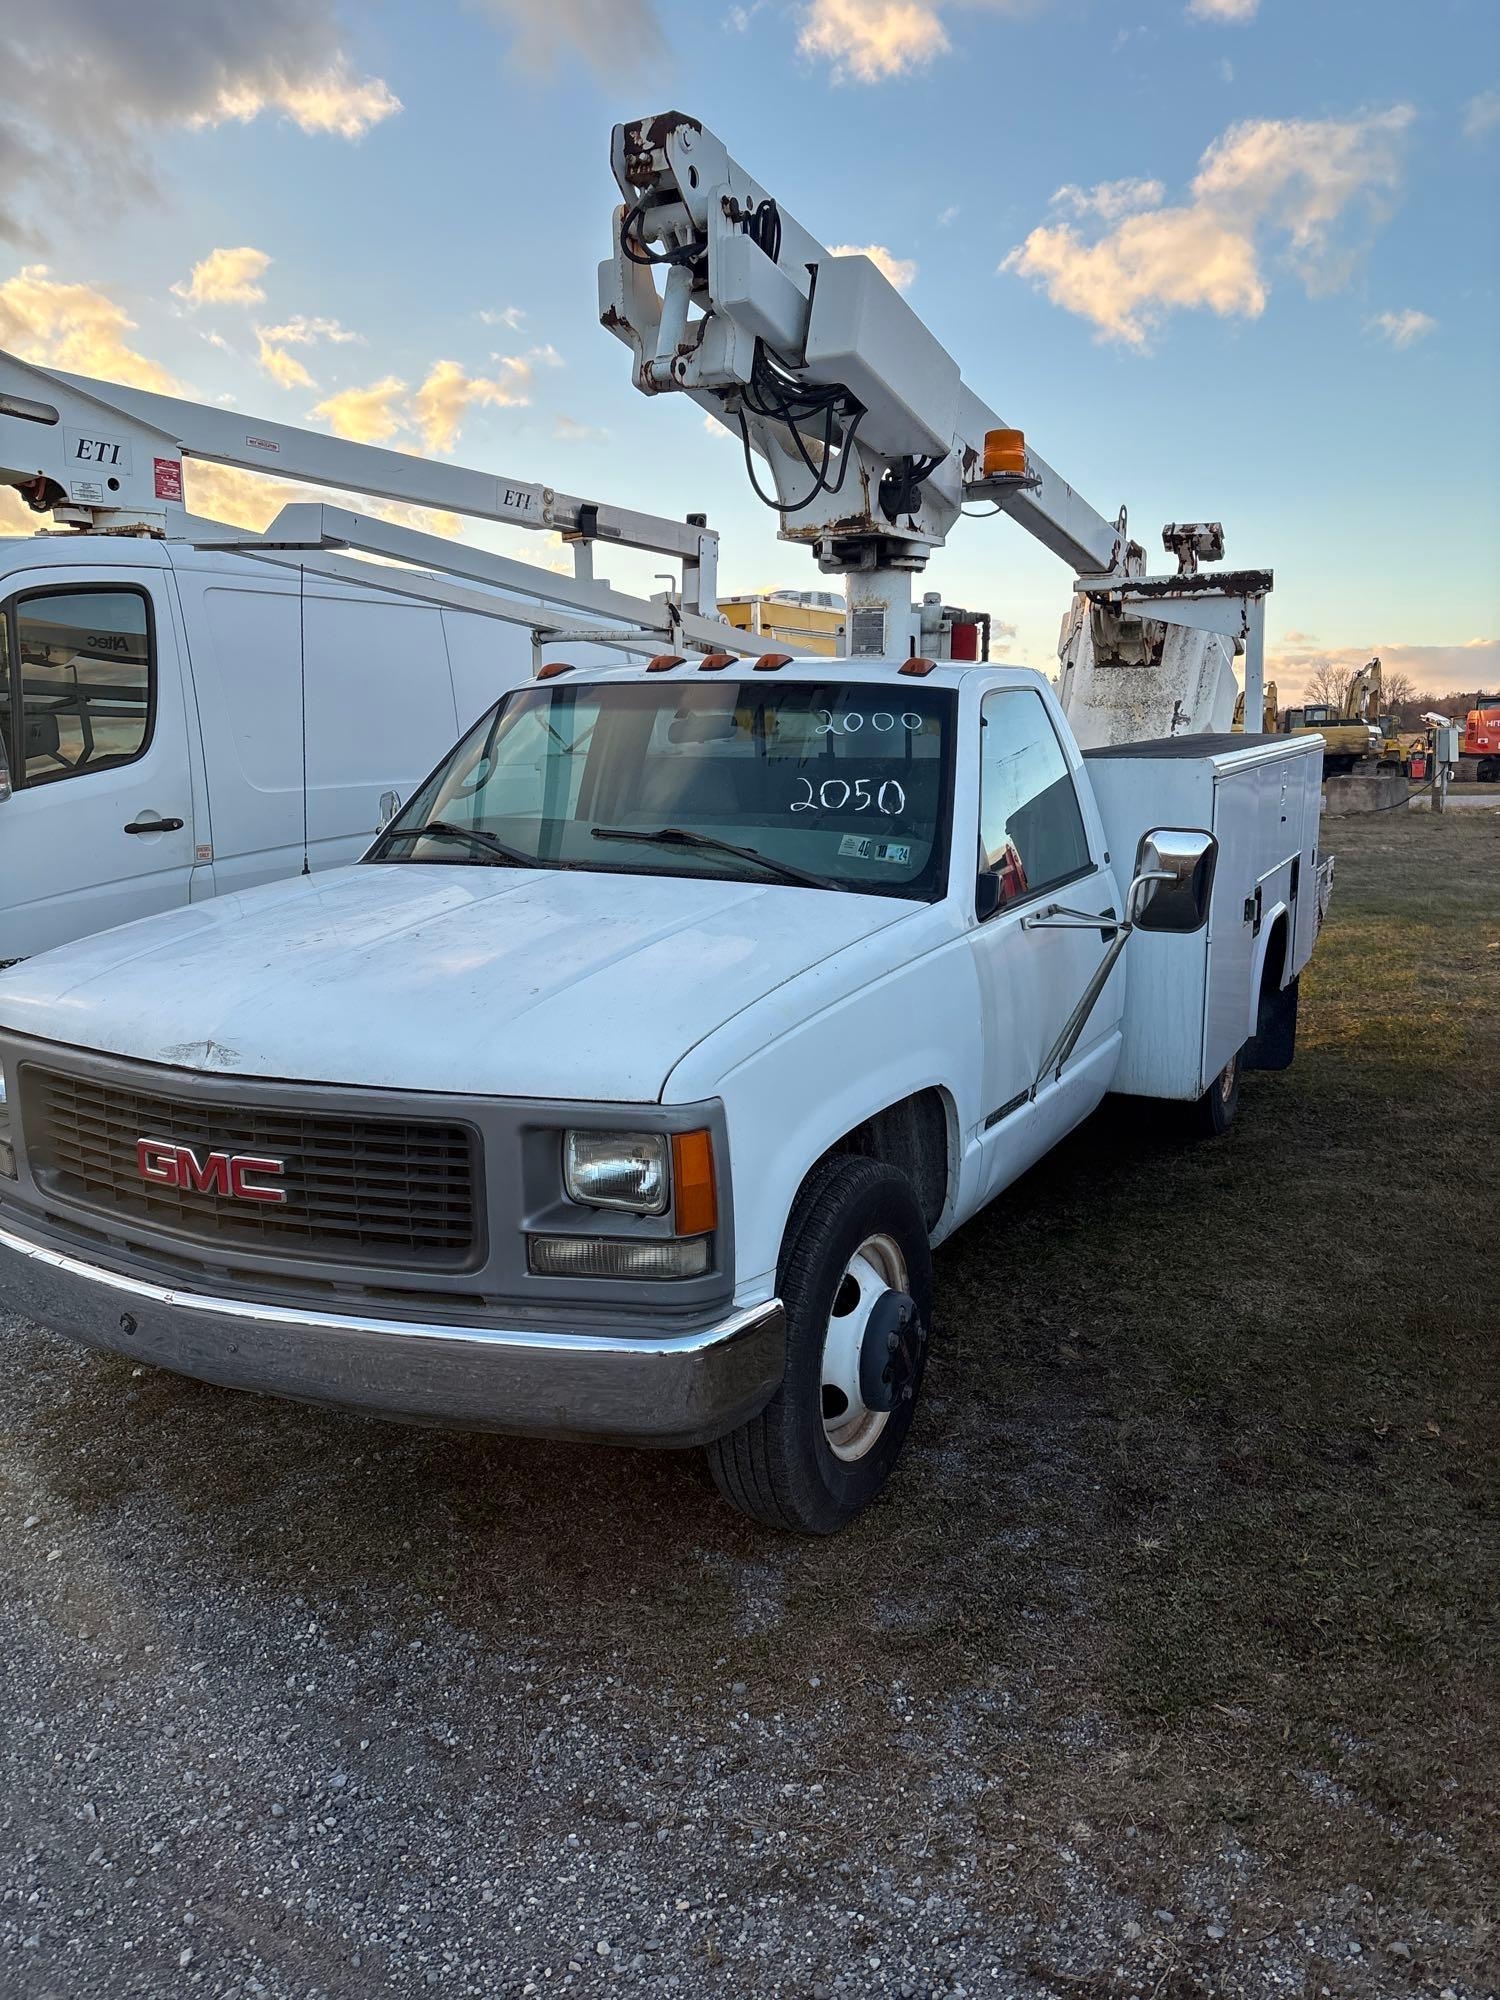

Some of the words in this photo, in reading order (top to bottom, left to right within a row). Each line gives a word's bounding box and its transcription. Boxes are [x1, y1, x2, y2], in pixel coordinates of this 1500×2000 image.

[815, 710, 922, 734] 2000
[790, 777, 906, 814] 2050
[137, 1138, 287, 1203] GMC
